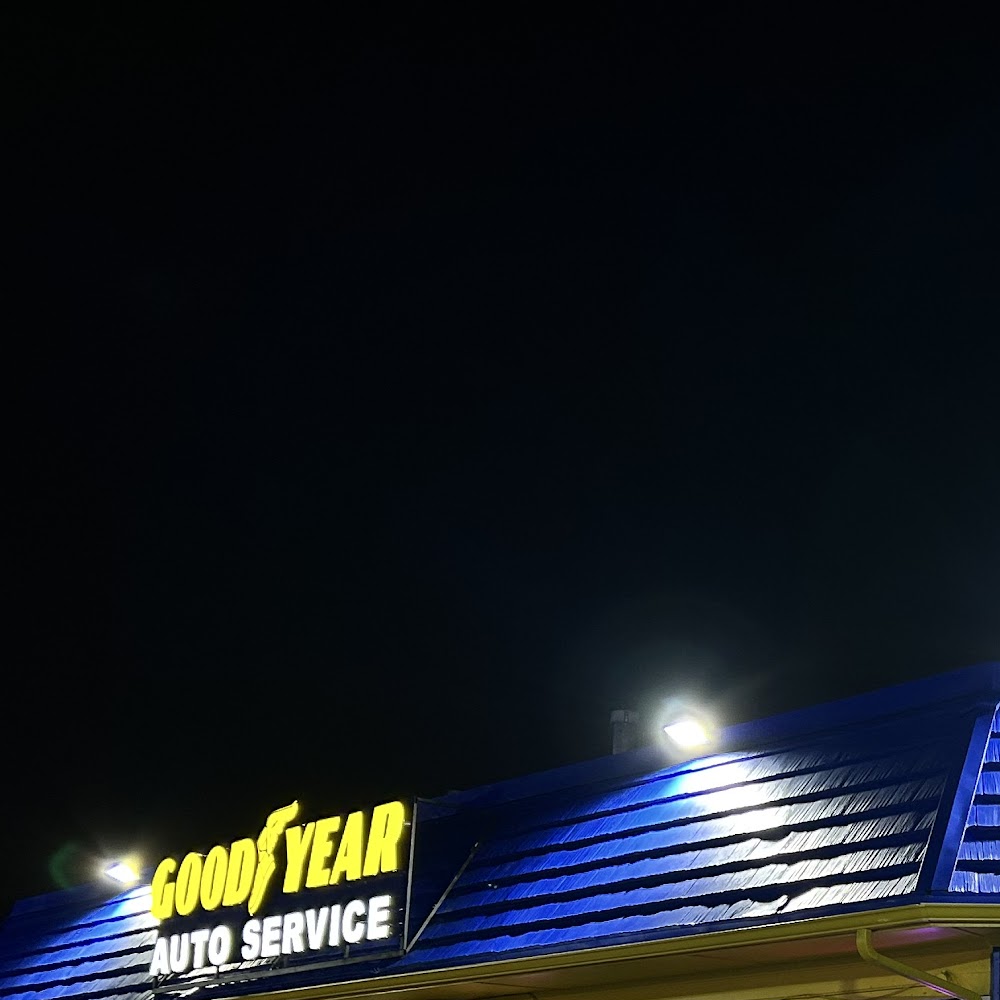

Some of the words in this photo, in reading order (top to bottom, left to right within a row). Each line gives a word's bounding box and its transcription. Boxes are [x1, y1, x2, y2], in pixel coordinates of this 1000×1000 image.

[150, 800, 405, 920] GOODYEAR
[150, 924, 232, 977] AUTO
[241, 894, 392, 960] SERVICE
